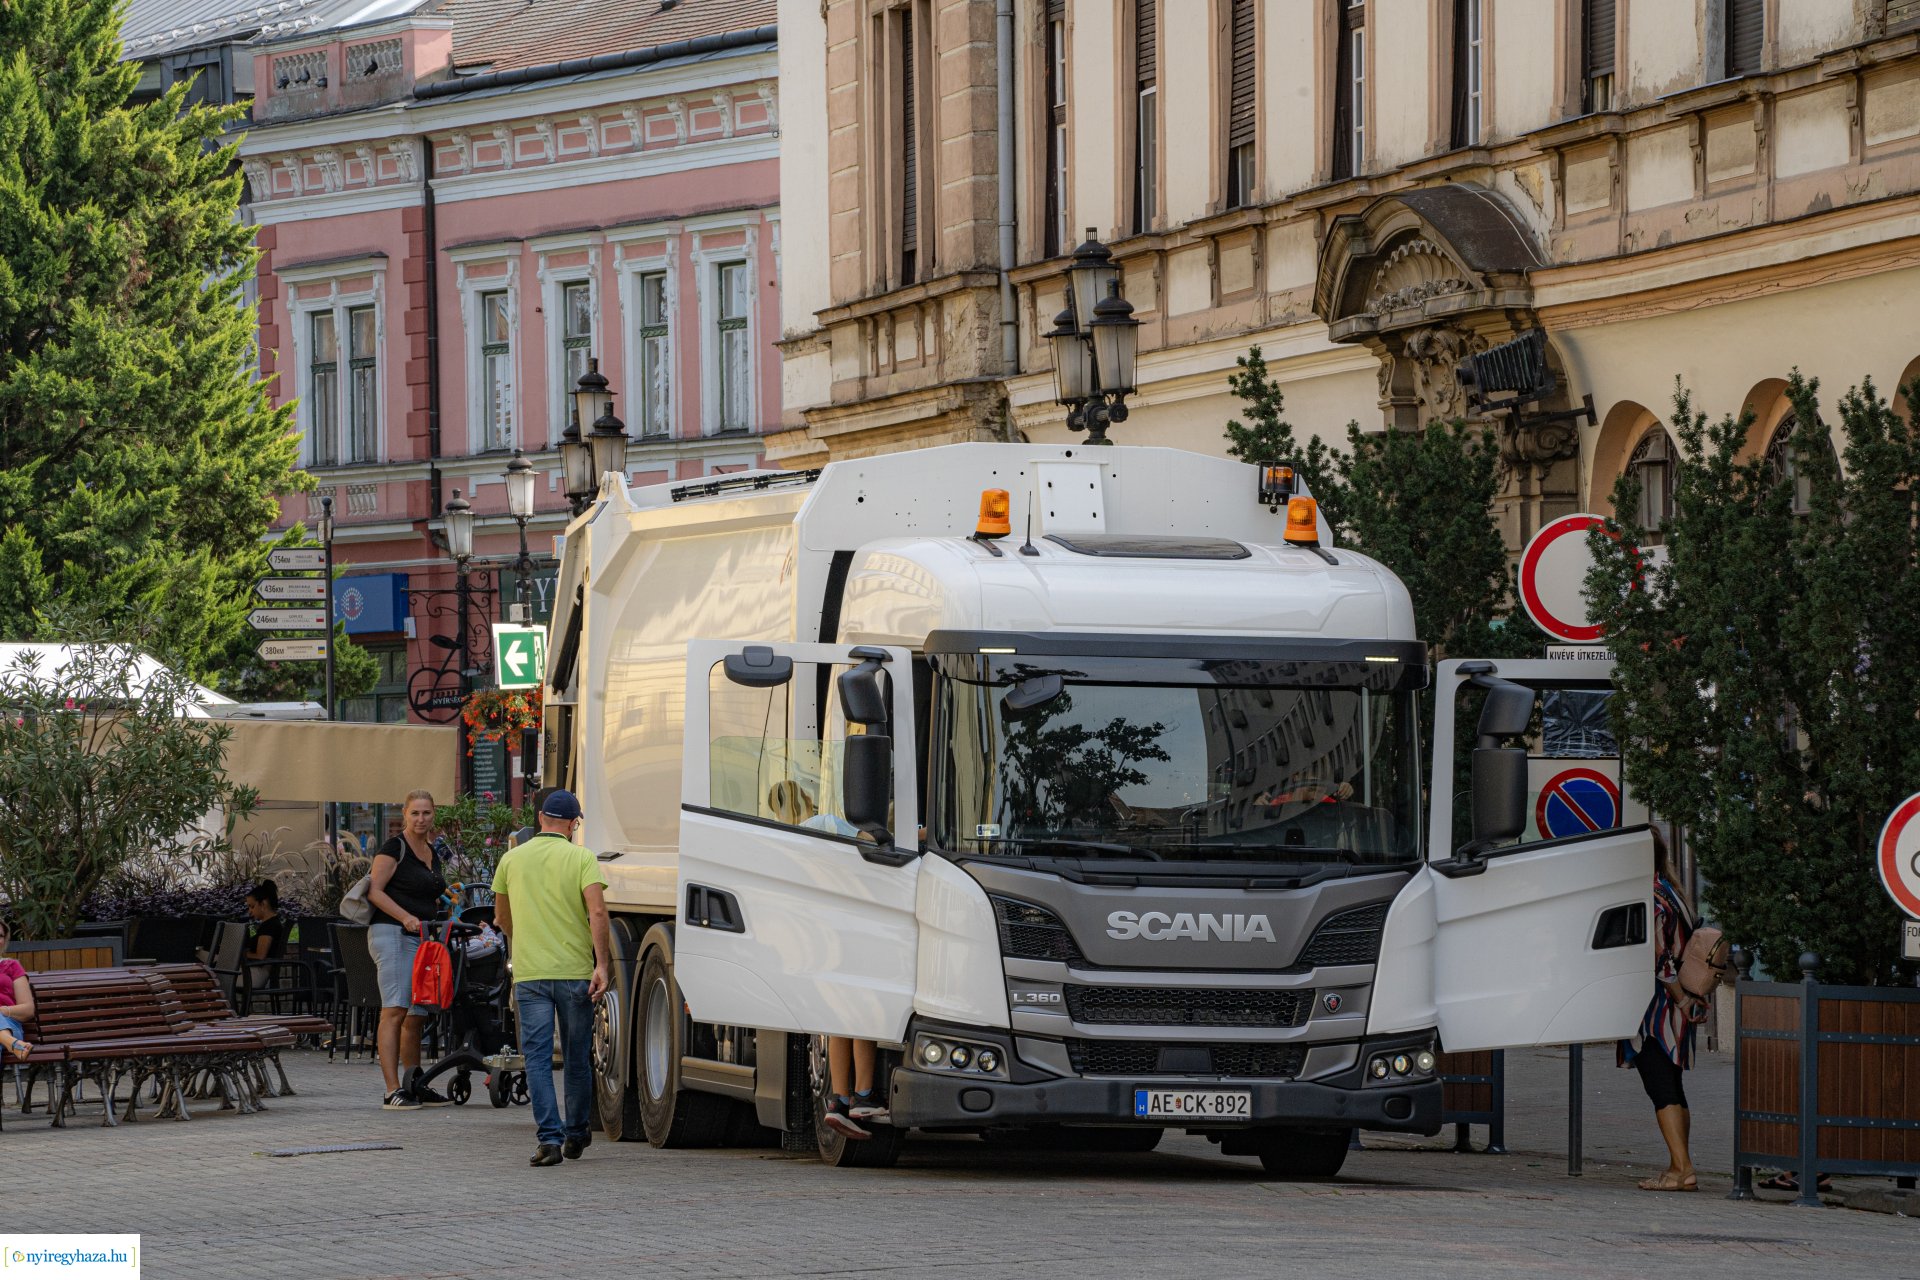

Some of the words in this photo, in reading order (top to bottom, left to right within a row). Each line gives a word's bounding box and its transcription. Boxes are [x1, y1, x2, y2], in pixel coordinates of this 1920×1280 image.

[274, 555, 291, 564] 754KM
[264, 585, 284, 593] 436KM
[256, 615, 278, 624] 246KM
[265, 646, 285, 655] 380KM
[1549, 648, 1575, 661] KIVÉVE
[1106, 910, 1277, 943] SCANIA
[1013, 993, 1024, 1003] L
[1026, 993, 1061, 1003] 360
[1139, 1104, 1145, 1112] H
[1150, 1094, 1174, 1113] AE
[1183, 1094, 1248, 1114] CK-892
